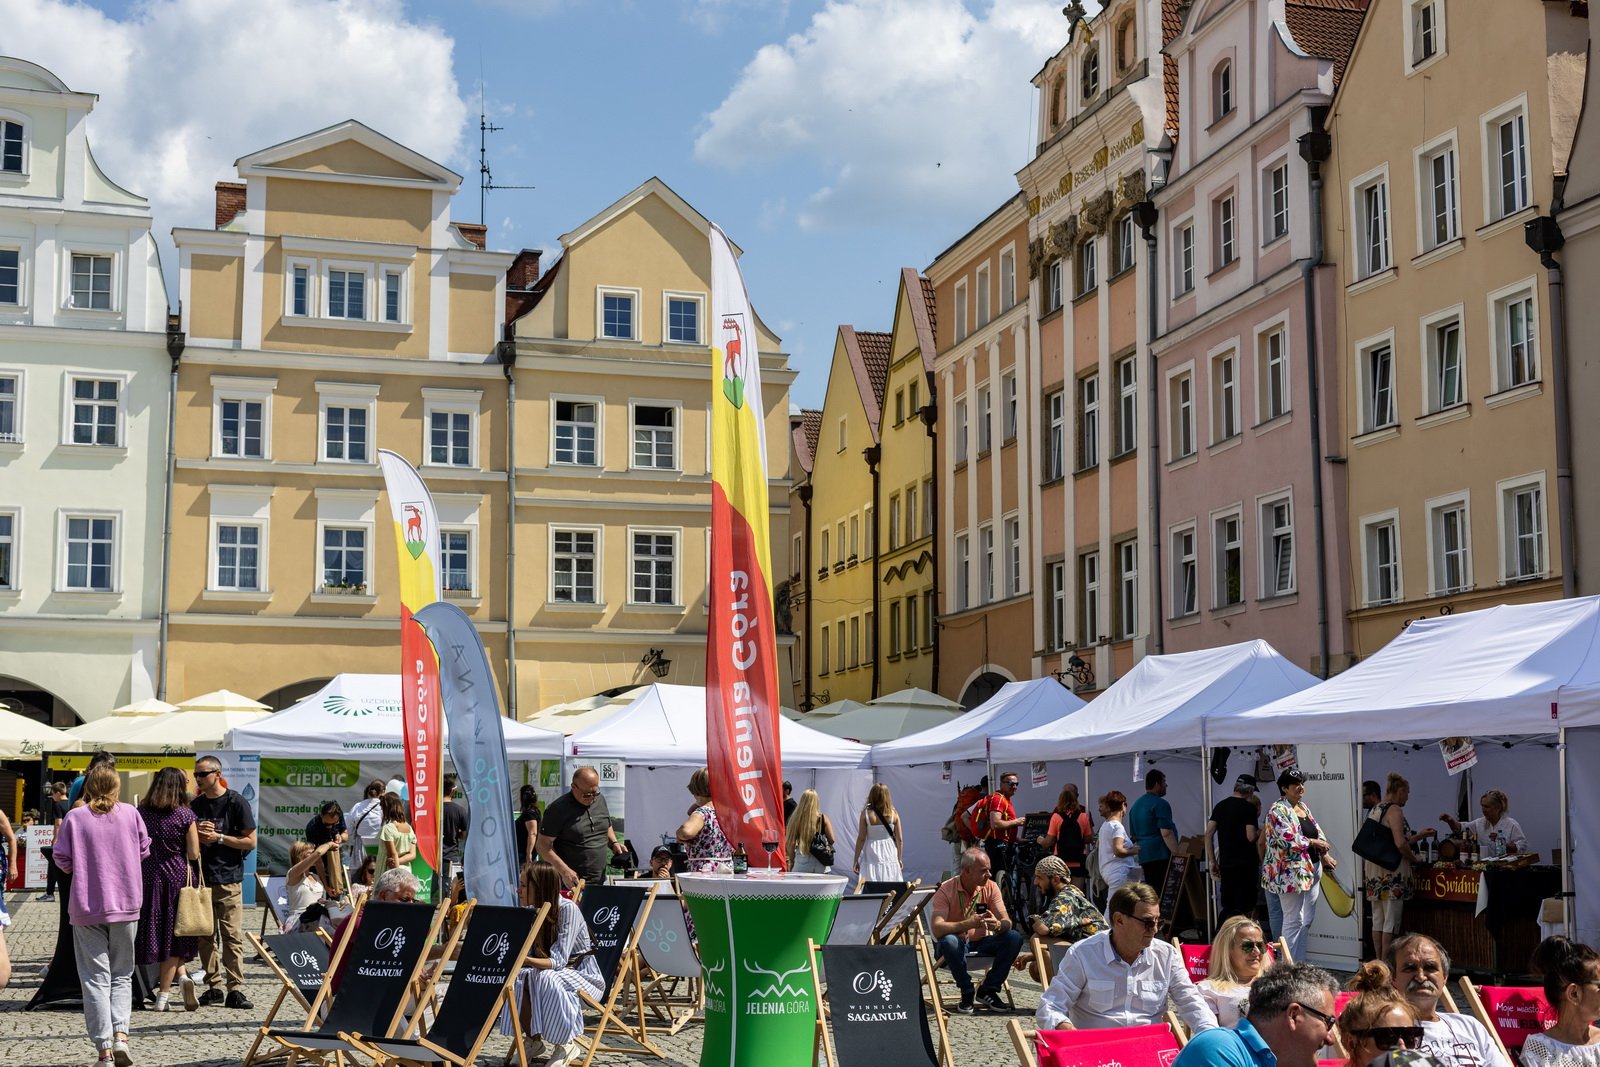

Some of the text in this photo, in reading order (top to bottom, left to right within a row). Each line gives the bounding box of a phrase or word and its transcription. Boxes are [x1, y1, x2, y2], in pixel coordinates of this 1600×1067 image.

[286, 773, 347, 786] CIEPLIC
[274, 804, 311, 816] narządu
[34, 829, 52, 837] SPEC
[37, 838, 53, 846] MEN
[1434, 872, 1480, 898] Świdnic
[357, 966, 404, 977] SAGANUM
[1190, 967, 1208, 976] WWW.
[299, 978, 324, 986] SAGAN
[464, 973, 506, 985] SAGANUM
[745, 1000, 810, 1015] JELENIA GÓRA
[847, 1011, 908, 1022] SAGANUM
